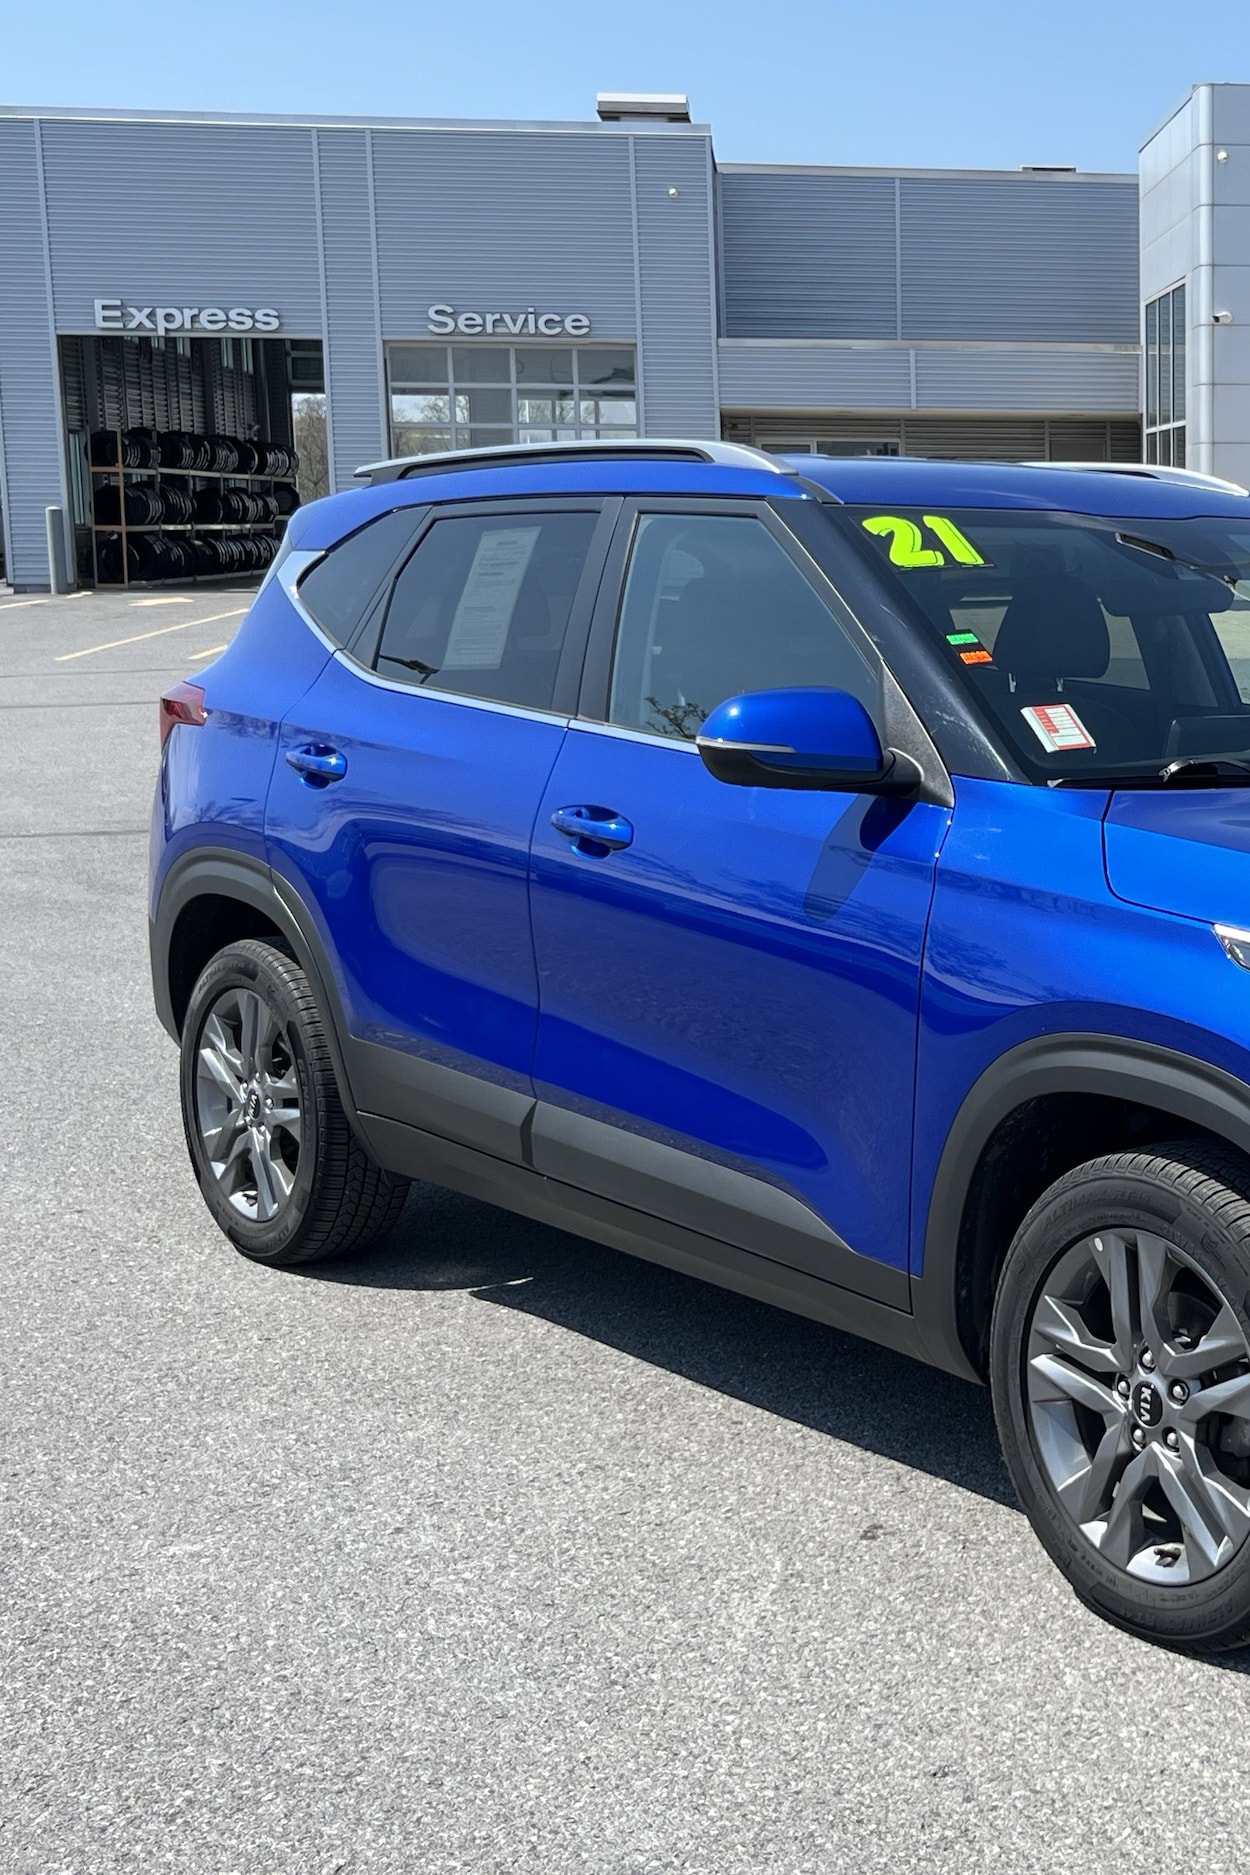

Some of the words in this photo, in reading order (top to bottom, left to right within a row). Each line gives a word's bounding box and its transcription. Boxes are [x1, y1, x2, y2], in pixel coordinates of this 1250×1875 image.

[93, 299, 281, 336] Express
[426, 303, 592, 337] Service
[862, 515, 984, 567] 21
[1140, 1386, 1152, 1421] KIA
